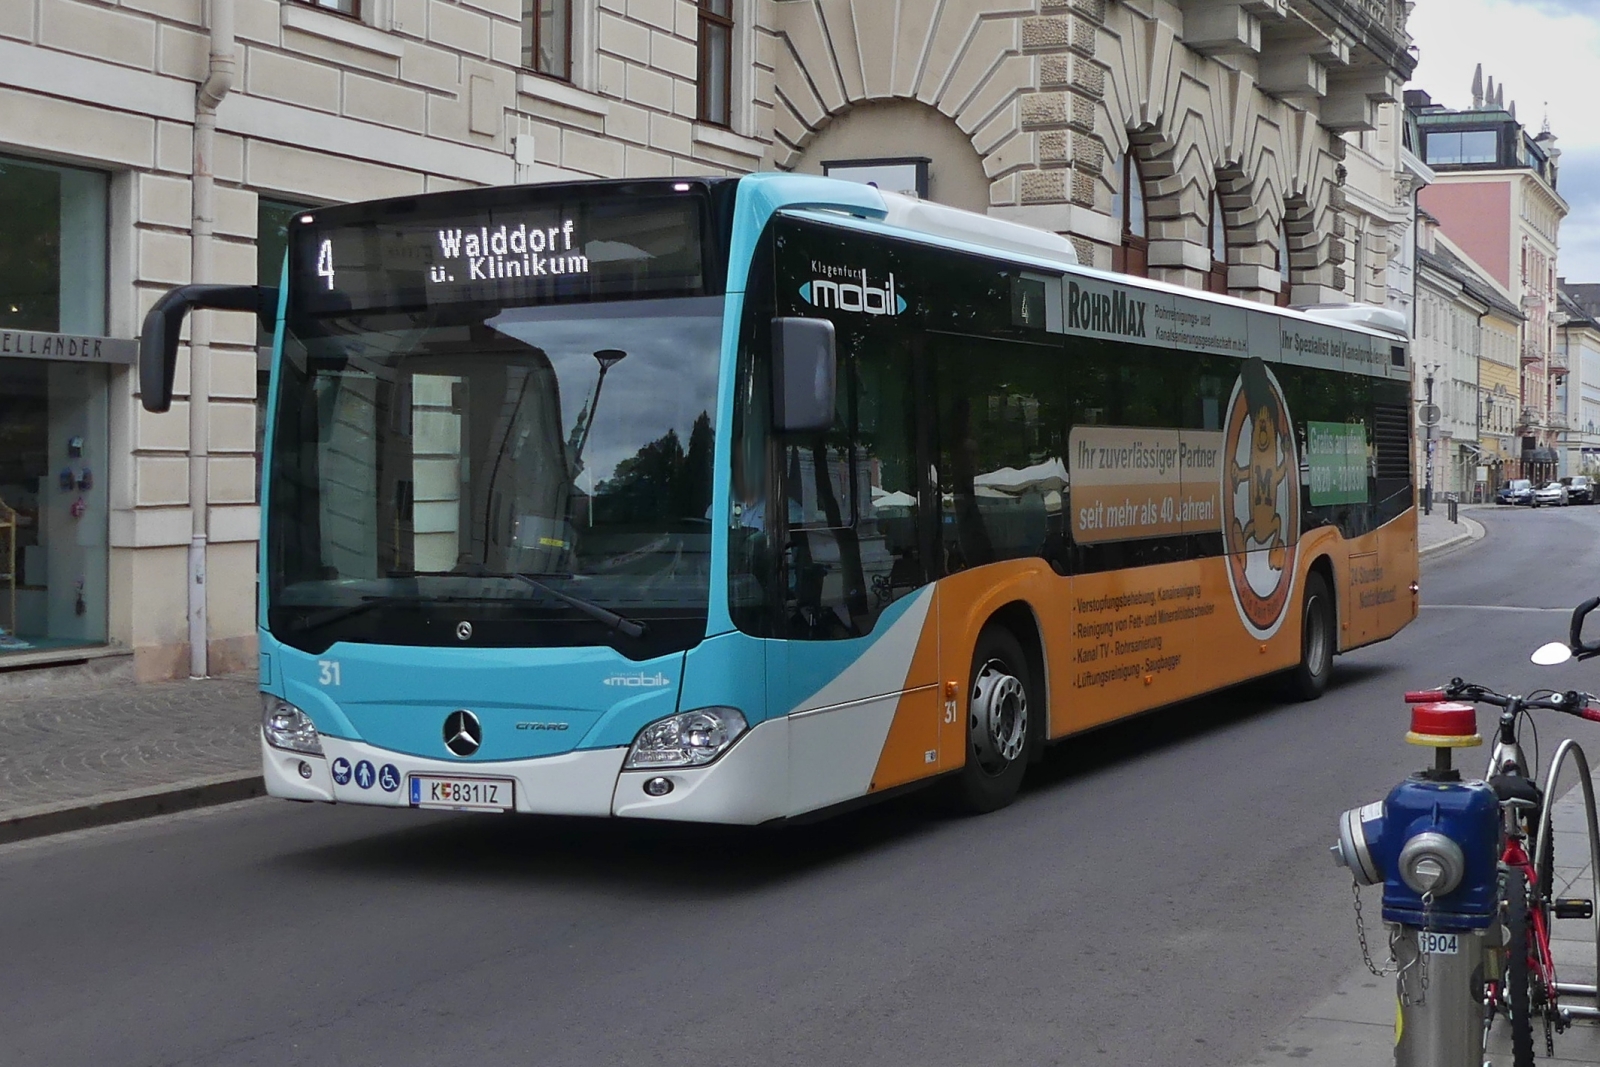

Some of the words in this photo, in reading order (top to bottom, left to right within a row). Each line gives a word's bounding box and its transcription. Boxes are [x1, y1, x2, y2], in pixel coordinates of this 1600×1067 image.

[438, 219, 575, 258] Walddorf
[316, 239, 335, 290] 4
[430, 266, 455, 284] ü.
[470, 253, 590, 281] Klinikum
[811, 260, 862, 279] Klagenfurt
[812, 268, 896, 316] mobil
[2, 333, 103, 358] ELLANDER
[1077, 440, 1096, 469] Ihr
[1099, 442, 1177, 475] zuverlässiger
[1179, 442, 1217, 468] Partner
[1079, 501, 1103, 531] seit
[1106, 498, 1138, 528] mehr
[1141, 498, 1158, 525] als
[1160, 496, 1174, 524] 40
[1175, 494, 1215, 521] Jahren!
[1077, 619, 1114, 639] Reinigung
[1114, 618, 1128, 631] von
[1145, 611, 1157, 626] und
[1077, 646, 1099, 664] Kanal
[1100, 643, 1110, 658] TV
[1115, 635, 1162, 656] Rohrsanierung
[318, 660, 341, 687] 31
[611, 671, 662, 687] mobil
[1077, 662, 1140, 689] Lüftungsreinigung
[515, 721, 570, 731] CITARO
[944, 700, 957, 724] 31
